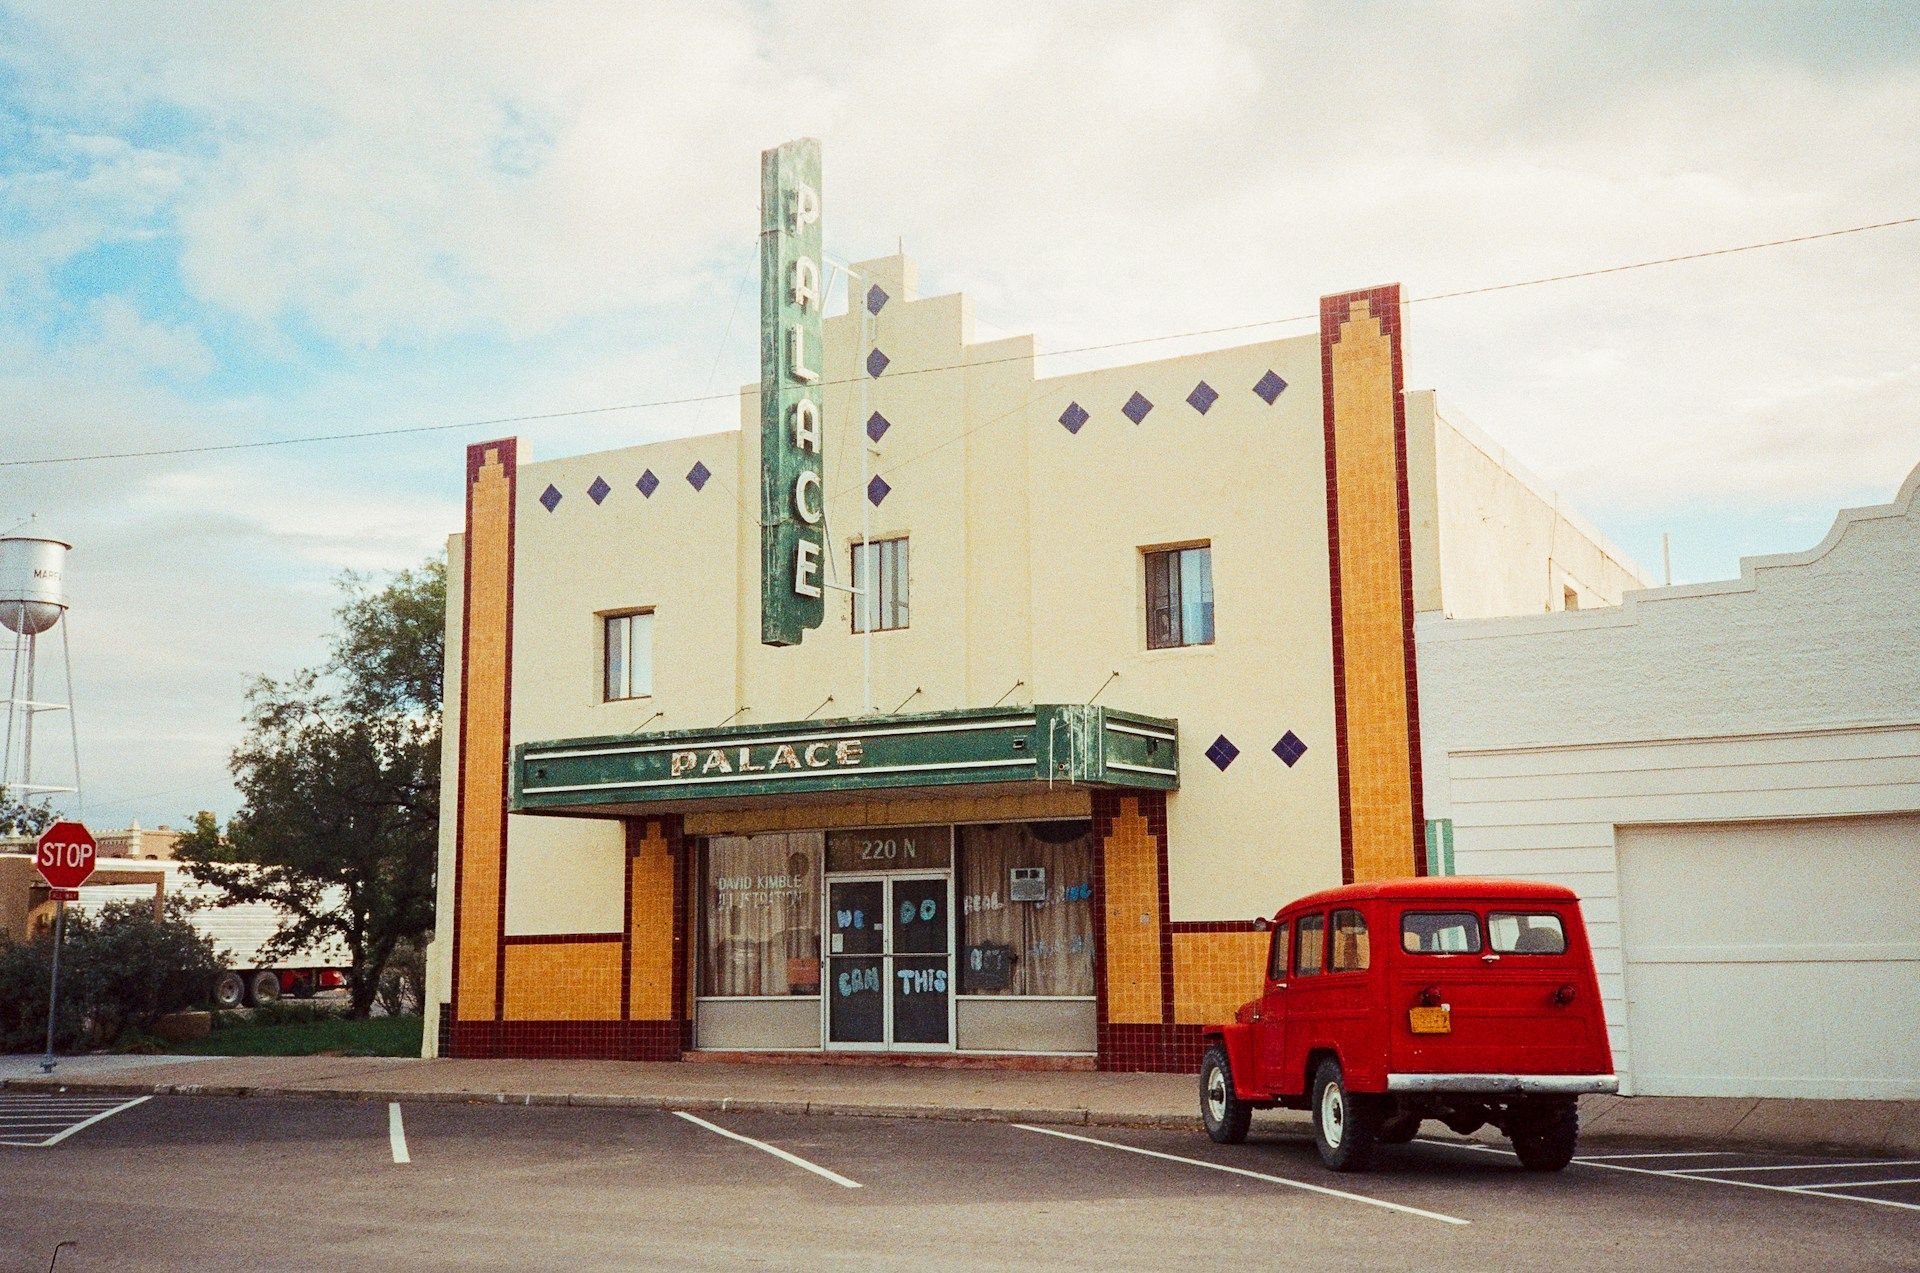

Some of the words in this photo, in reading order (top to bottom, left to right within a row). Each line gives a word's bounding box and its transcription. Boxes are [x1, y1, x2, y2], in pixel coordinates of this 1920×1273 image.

[789, 182, 822, 599] PALACE
[670, 739, 864, 778] PALACE
[41, 842, 93, 868] STOP
[861, 839, 897, 860] 220
[904, 838, 916, 858] N
[718, 876, 752, 890] DAVID
[757, 874, 802, 889] KIMBLE
[836, 909, 864, 930] WE
[899, 898, 937, 924] DO
[838, 966, 880, 997] CAN
[897, 968, 947, 995] THIS
